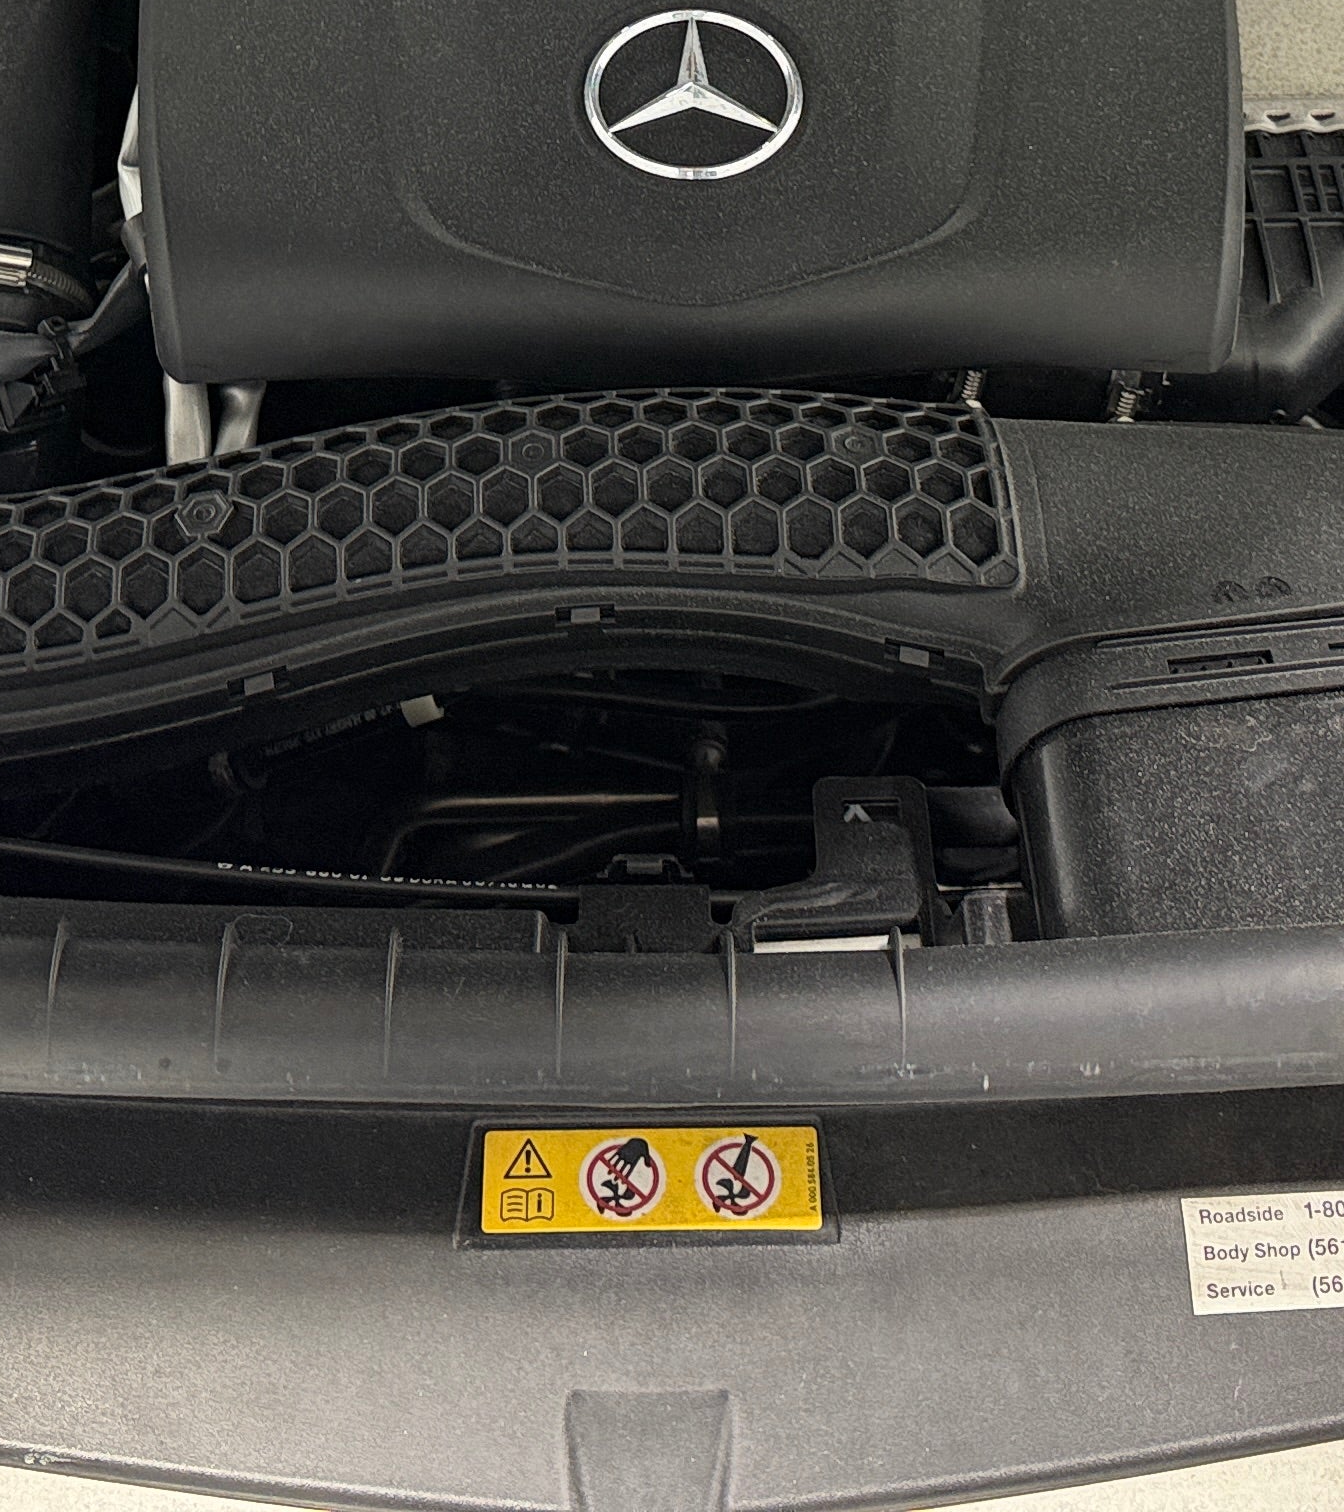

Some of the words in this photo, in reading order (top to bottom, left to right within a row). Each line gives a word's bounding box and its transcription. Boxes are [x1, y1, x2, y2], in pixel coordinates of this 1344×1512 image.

[806, 1142, 815, 1153] 26
[808, 1186, 817, 1203] 000
[1199, 1205, 1284, 1224] Roadside
[1203, 1243, 1249, 1263] Body
[1254, 1242, 1301, 1260] Shop
[1206, 1281, 1275, 1299] Service
